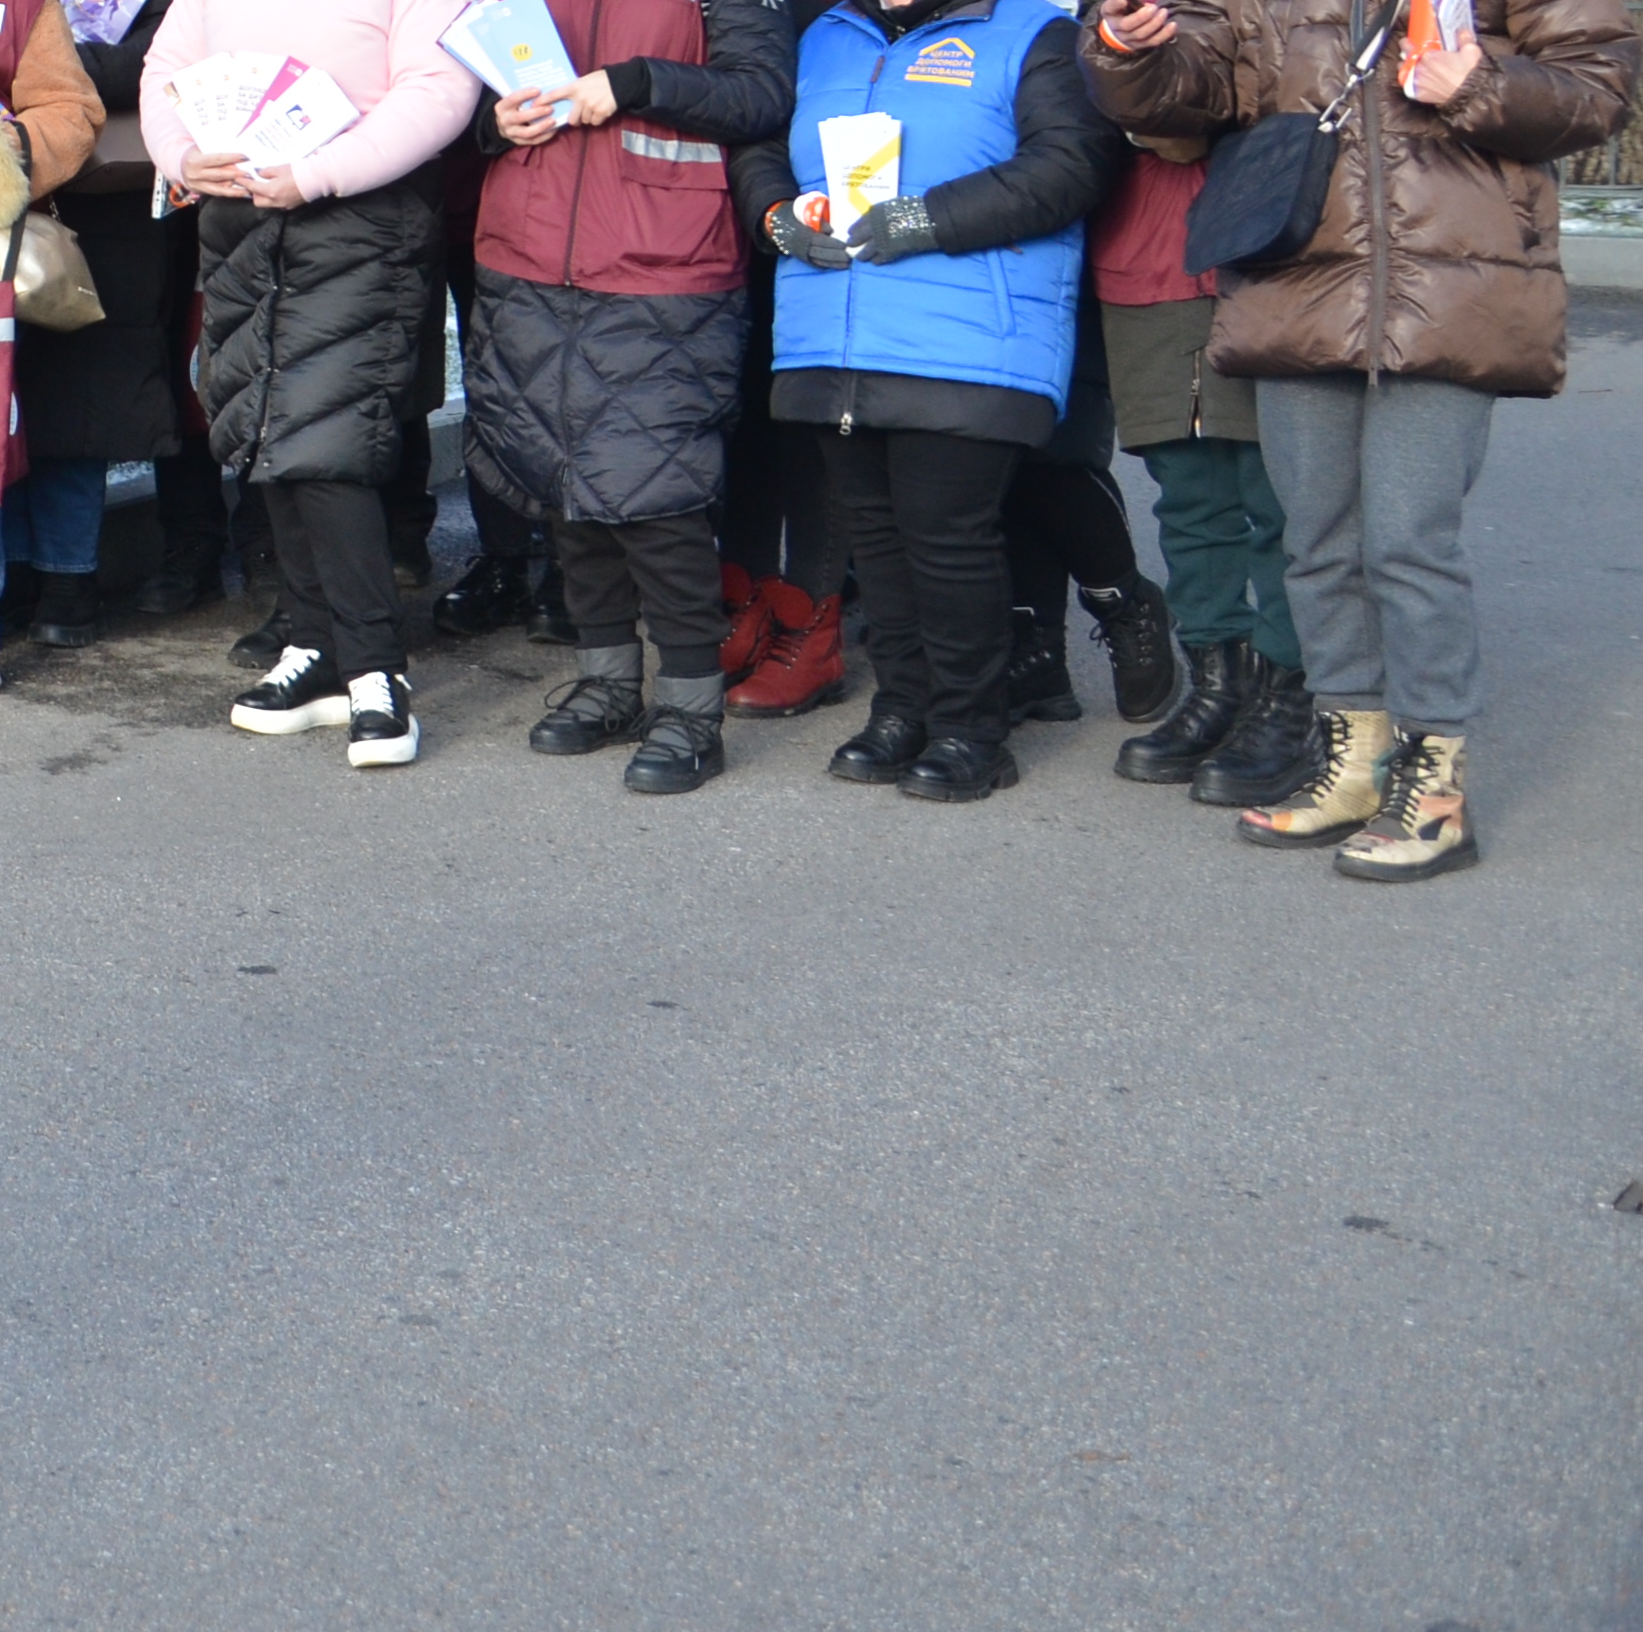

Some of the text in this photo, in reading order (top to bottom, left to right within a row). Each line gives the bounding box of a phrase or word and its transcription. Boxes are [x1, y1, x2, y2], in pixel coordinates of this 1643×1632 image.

[930, 50, 964, 59] ЦЕНТР
[916, 58, 973, 68] ДОПОМОГИ
[906, 65, 976, 79] ВРЯТОВАНИМ
